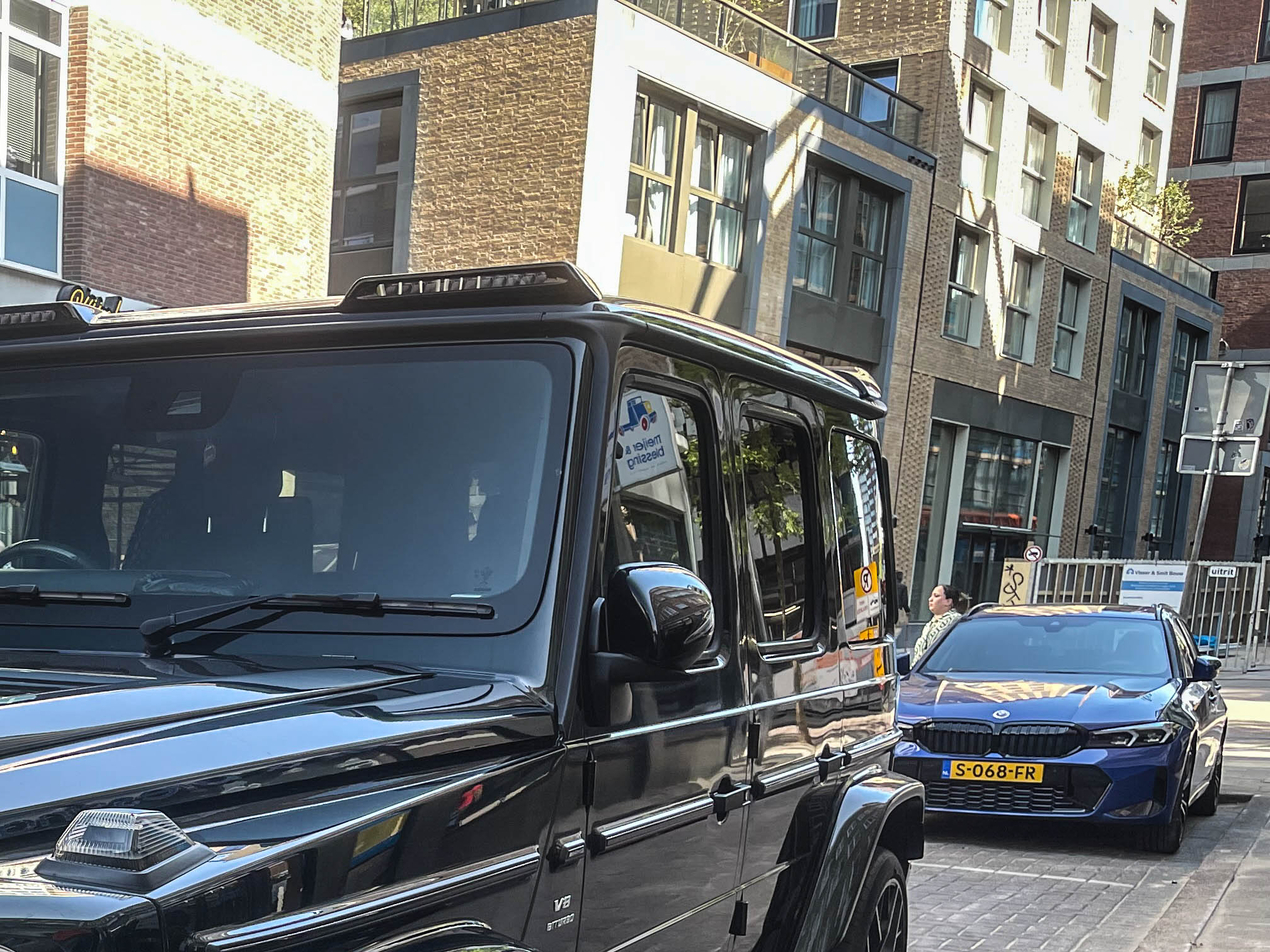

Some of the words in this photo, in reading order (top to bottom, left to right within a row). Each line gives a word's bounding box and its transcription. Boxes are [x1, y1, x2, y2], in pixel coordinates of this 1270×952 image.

[1211, 566, 1234, 576] uitrit
[955, 763, 1036, 780] S-068-FR
[553, 894, 571, 912] V8
